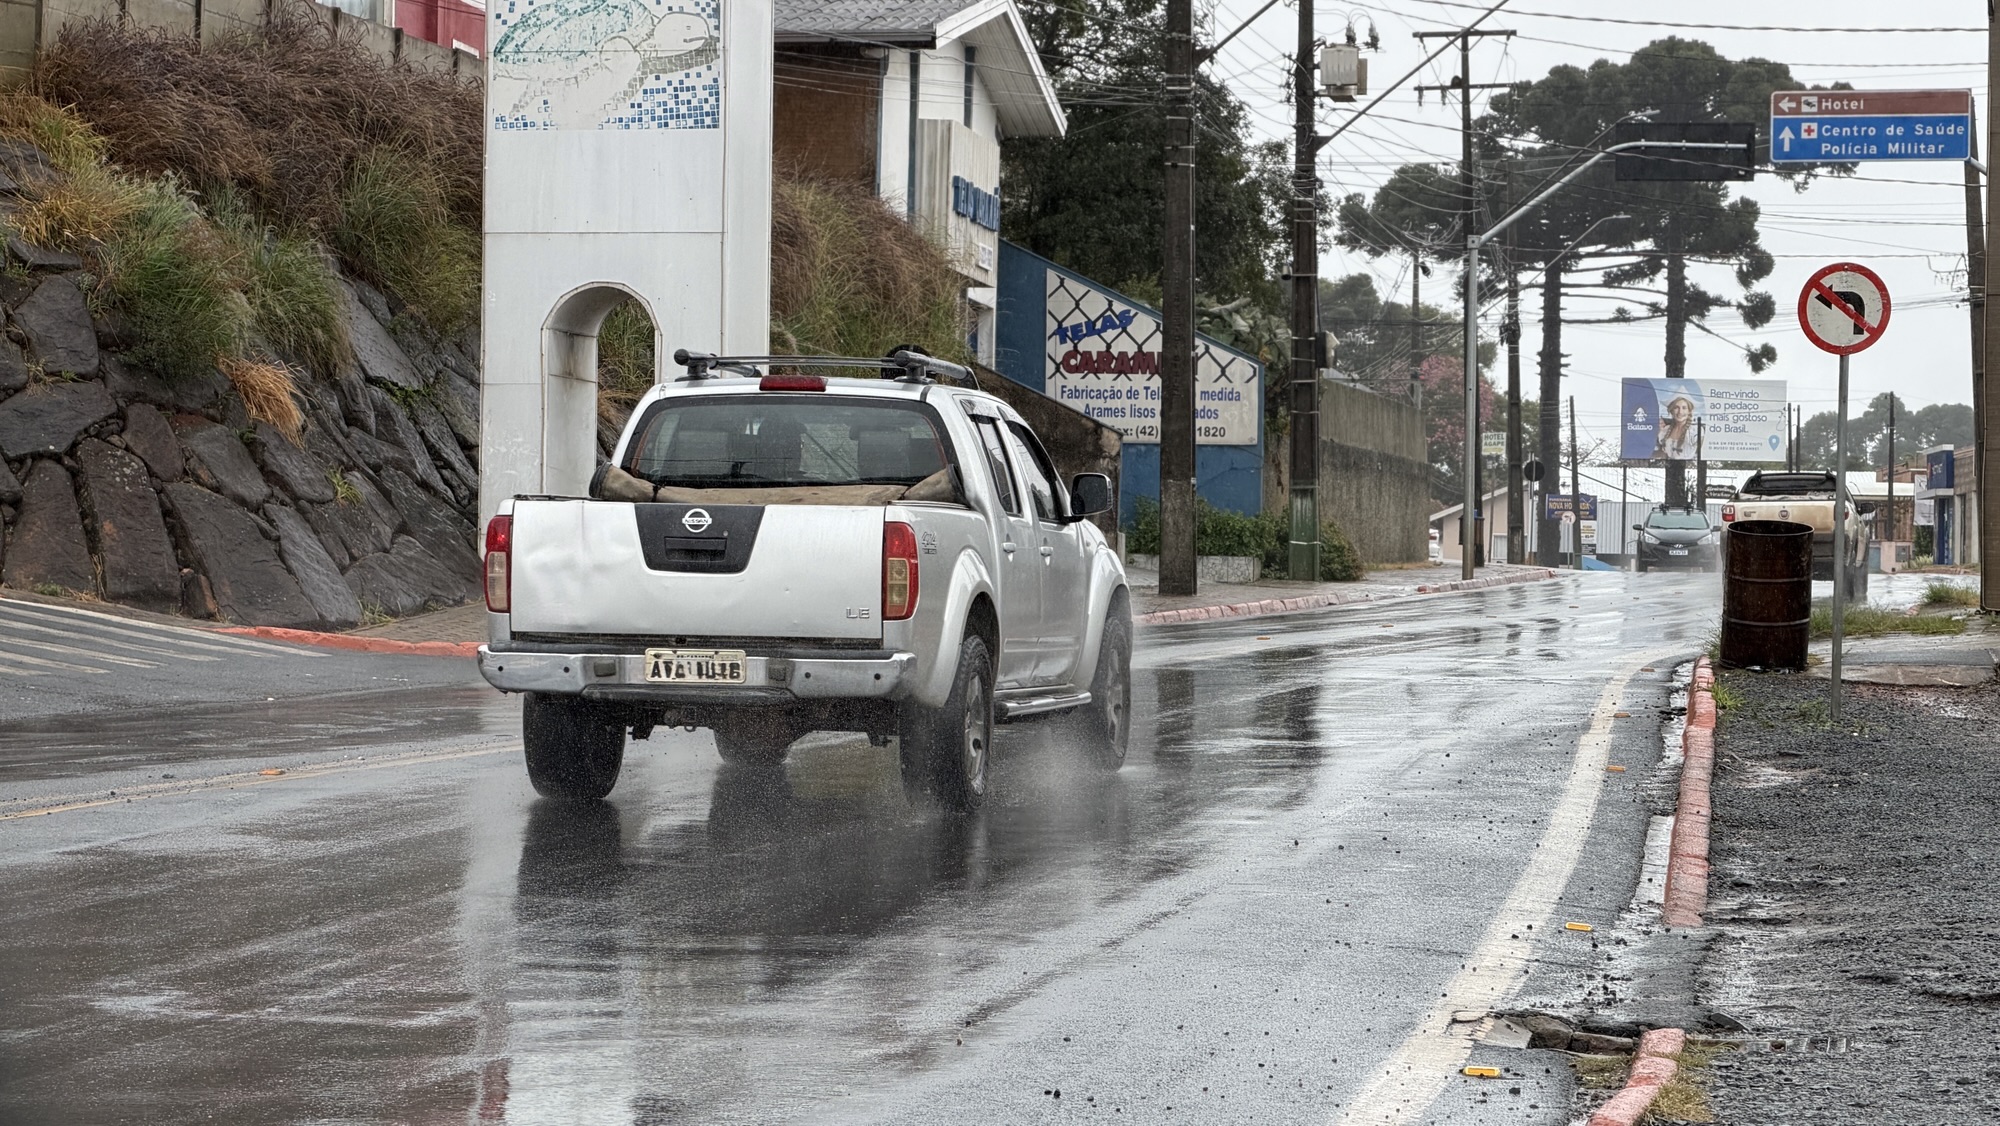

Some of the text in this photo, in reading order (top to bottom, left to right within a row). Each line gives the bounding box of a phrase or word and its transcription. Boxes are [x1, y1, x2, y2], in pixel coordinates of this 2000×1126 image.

[1821, 98, 1864, 111] Hotel
[1821, 122, 1965, 137] Centro de Saúde
[1821, 142, 1944, 155] Polícia Militar
[1054, 309, 1133, 345] TELAS
[1062, 350, 1198, 375] CARAM
[1060, 385, 1161, 404] Fabricação de Tel
[1200, 387, 1241, 402] medida
[1710, 389, 1760, 399] Bem-vindo
[1083, 403, 1156, 418] Arames lisos
[1709, 401, 1759, 412] ao pedaço
[1709, 413, 1768, 424] mais gostoso
[1135, 425, 1159, 439] (42)
[1196, 426, 1226, 438] 1820
[1709, 424, 1722, 433] do
[1484, 433, 1505, 441] HOTEL
[1548, 502, 1563, 510] NOVA
[845, 607, 870, 619] LE
